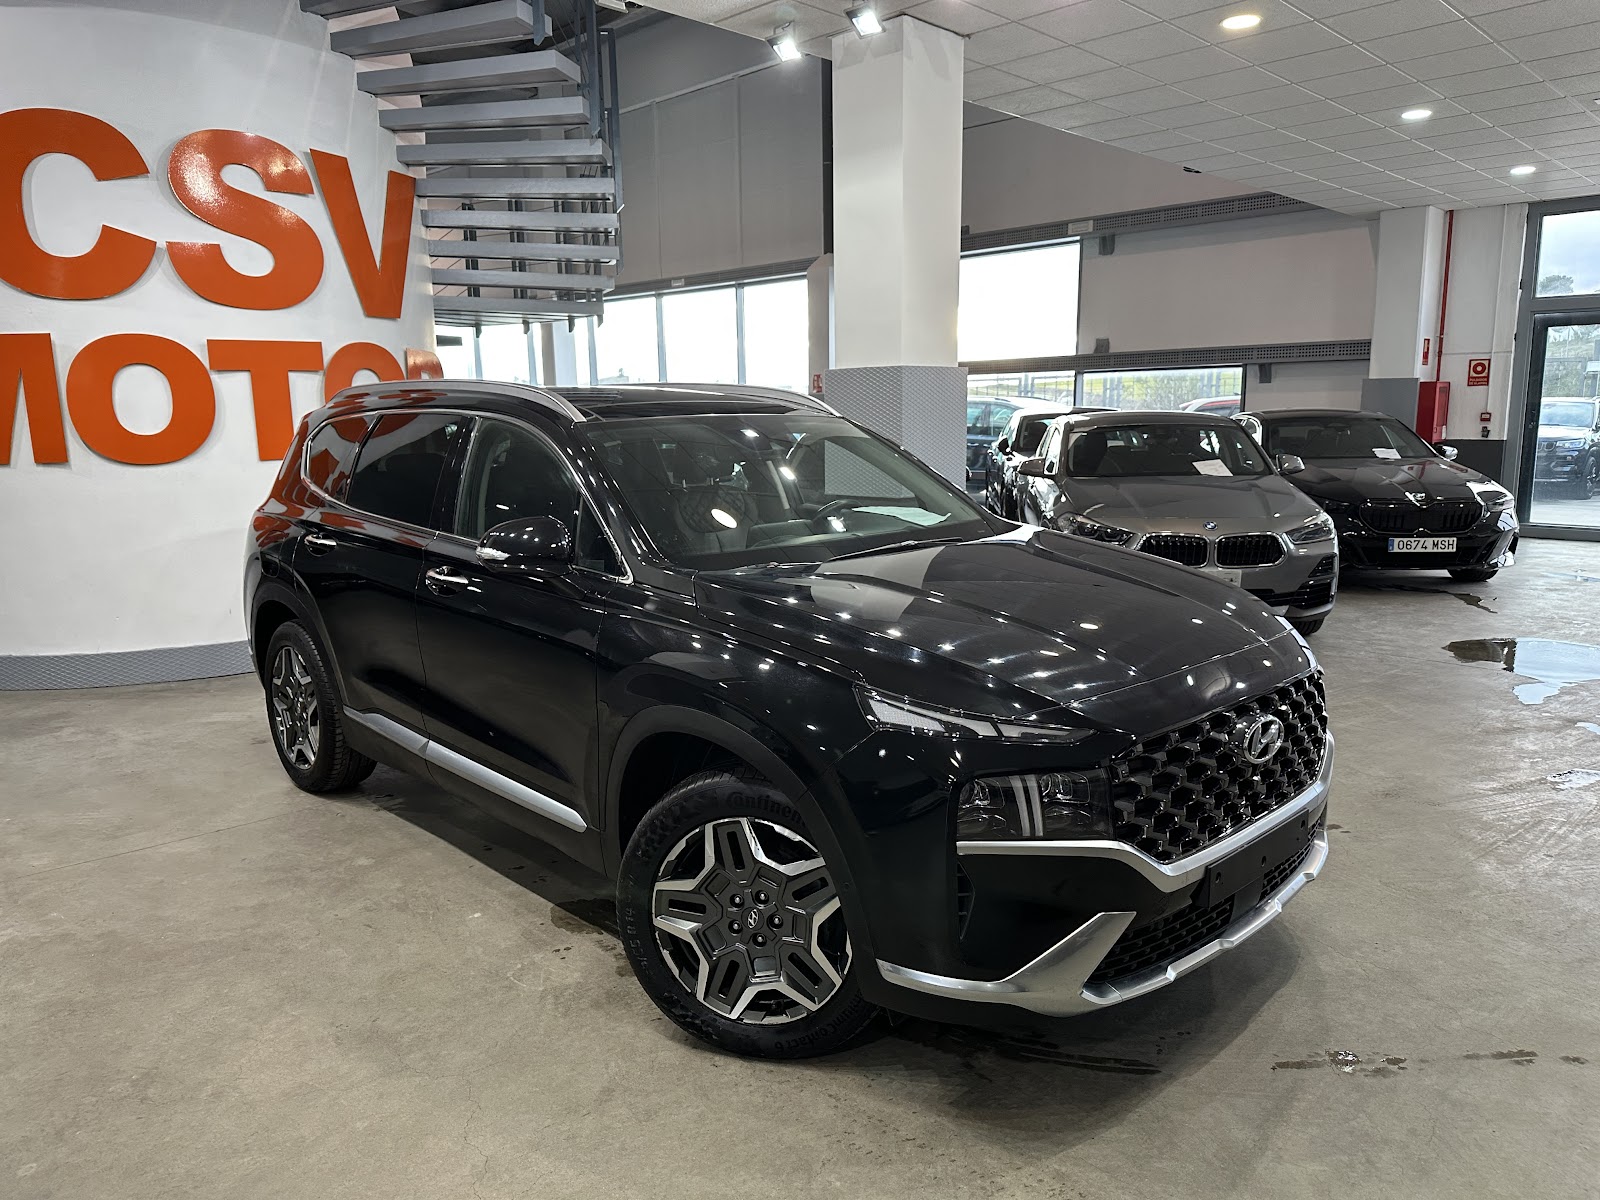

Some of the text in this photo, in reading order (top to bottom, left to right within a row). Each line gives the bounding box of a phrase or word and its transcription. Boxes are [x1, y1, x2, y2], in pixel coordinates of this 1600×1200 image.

[0, 107, 416, 319] CSV
[0, 333, 444, 465] MOT
[1397, 539, 1455, 550] 0674 MSH
